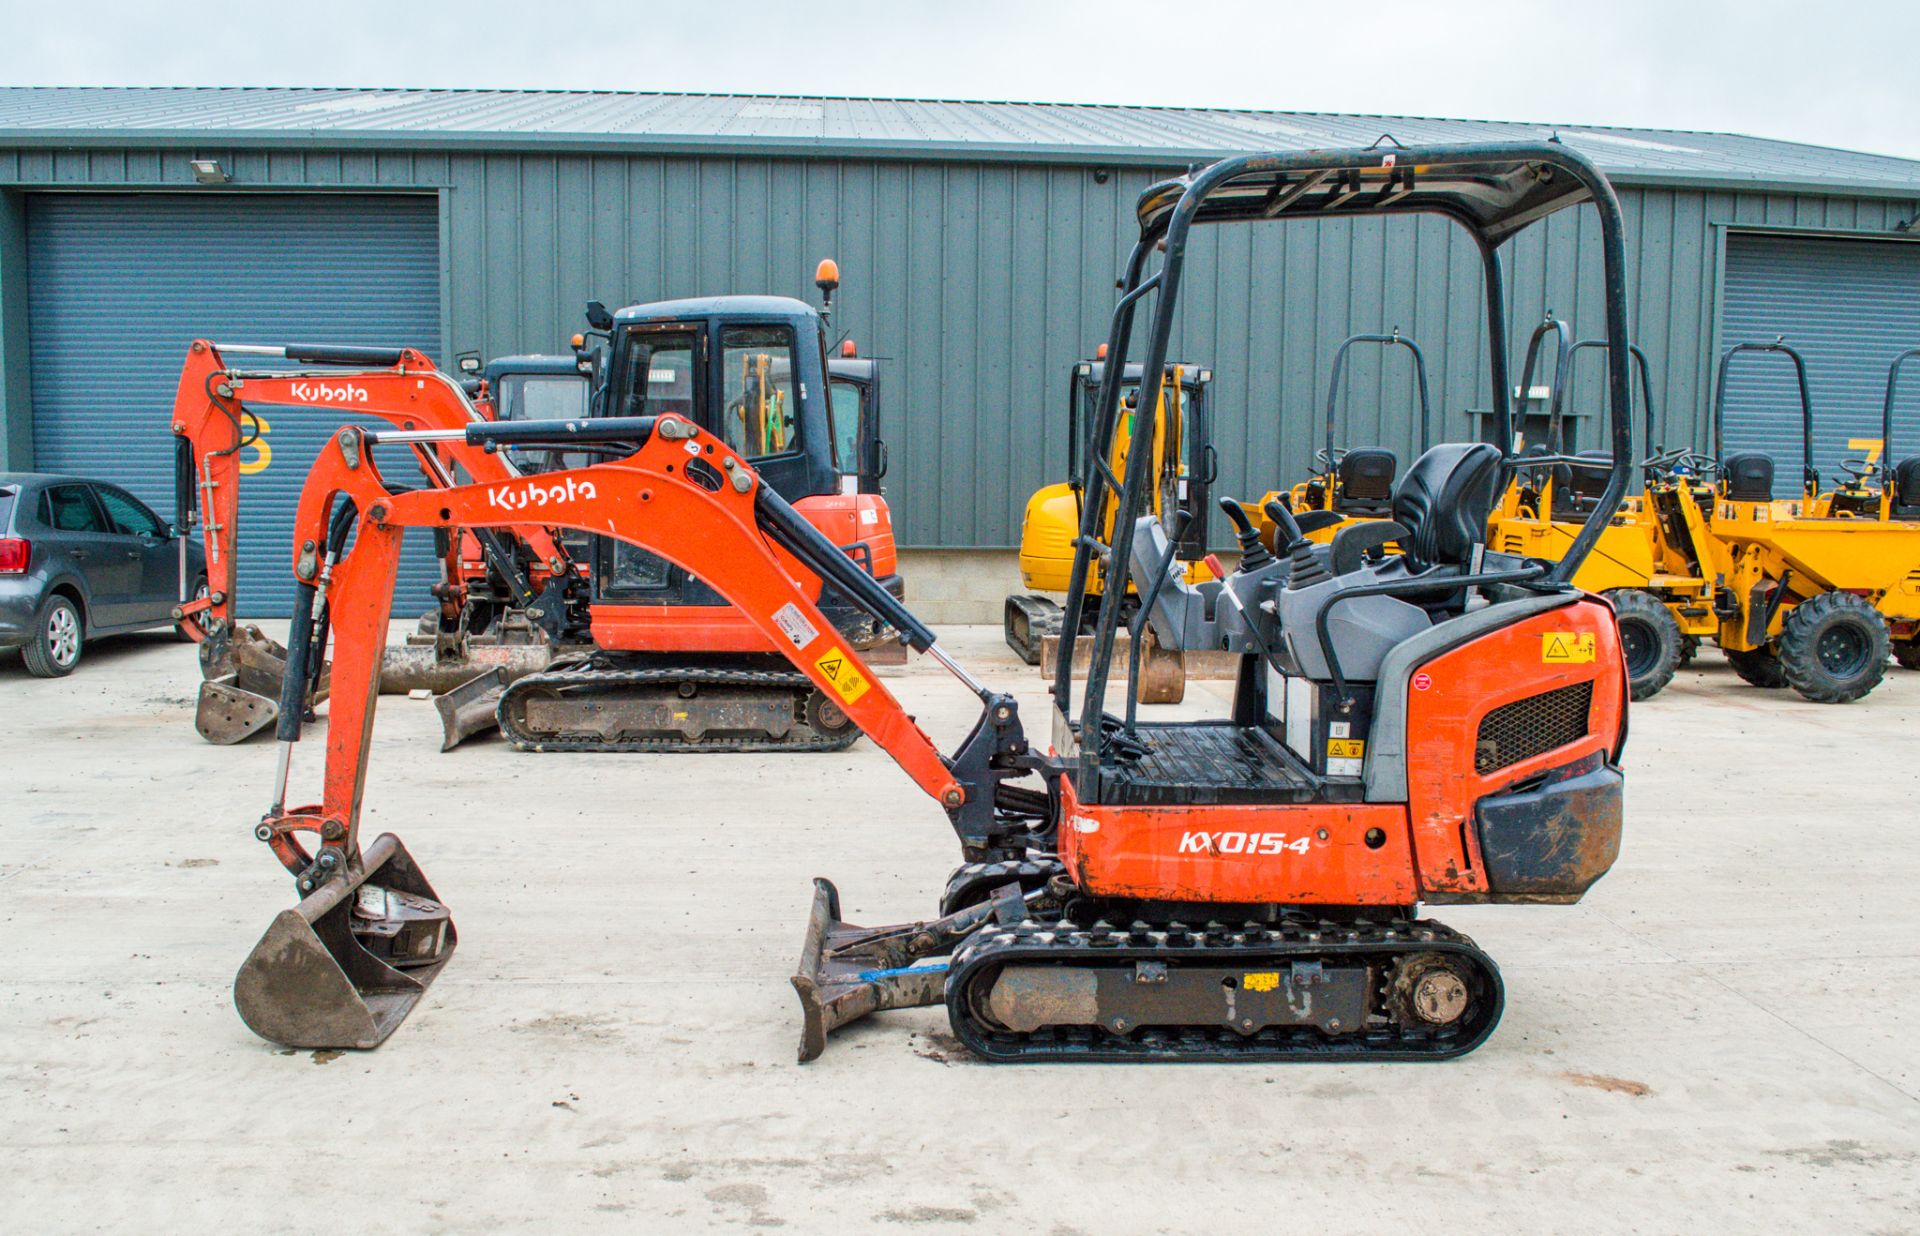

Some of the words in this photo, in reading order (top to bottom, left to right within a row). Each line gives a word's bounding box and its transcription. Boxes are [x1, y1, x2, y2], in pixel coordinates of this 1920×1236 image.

[291, 383, 368, 402] Kubota
[487, 477, 597, 511] Kubota
[1178, 831, 1311, 855] KX015-4
